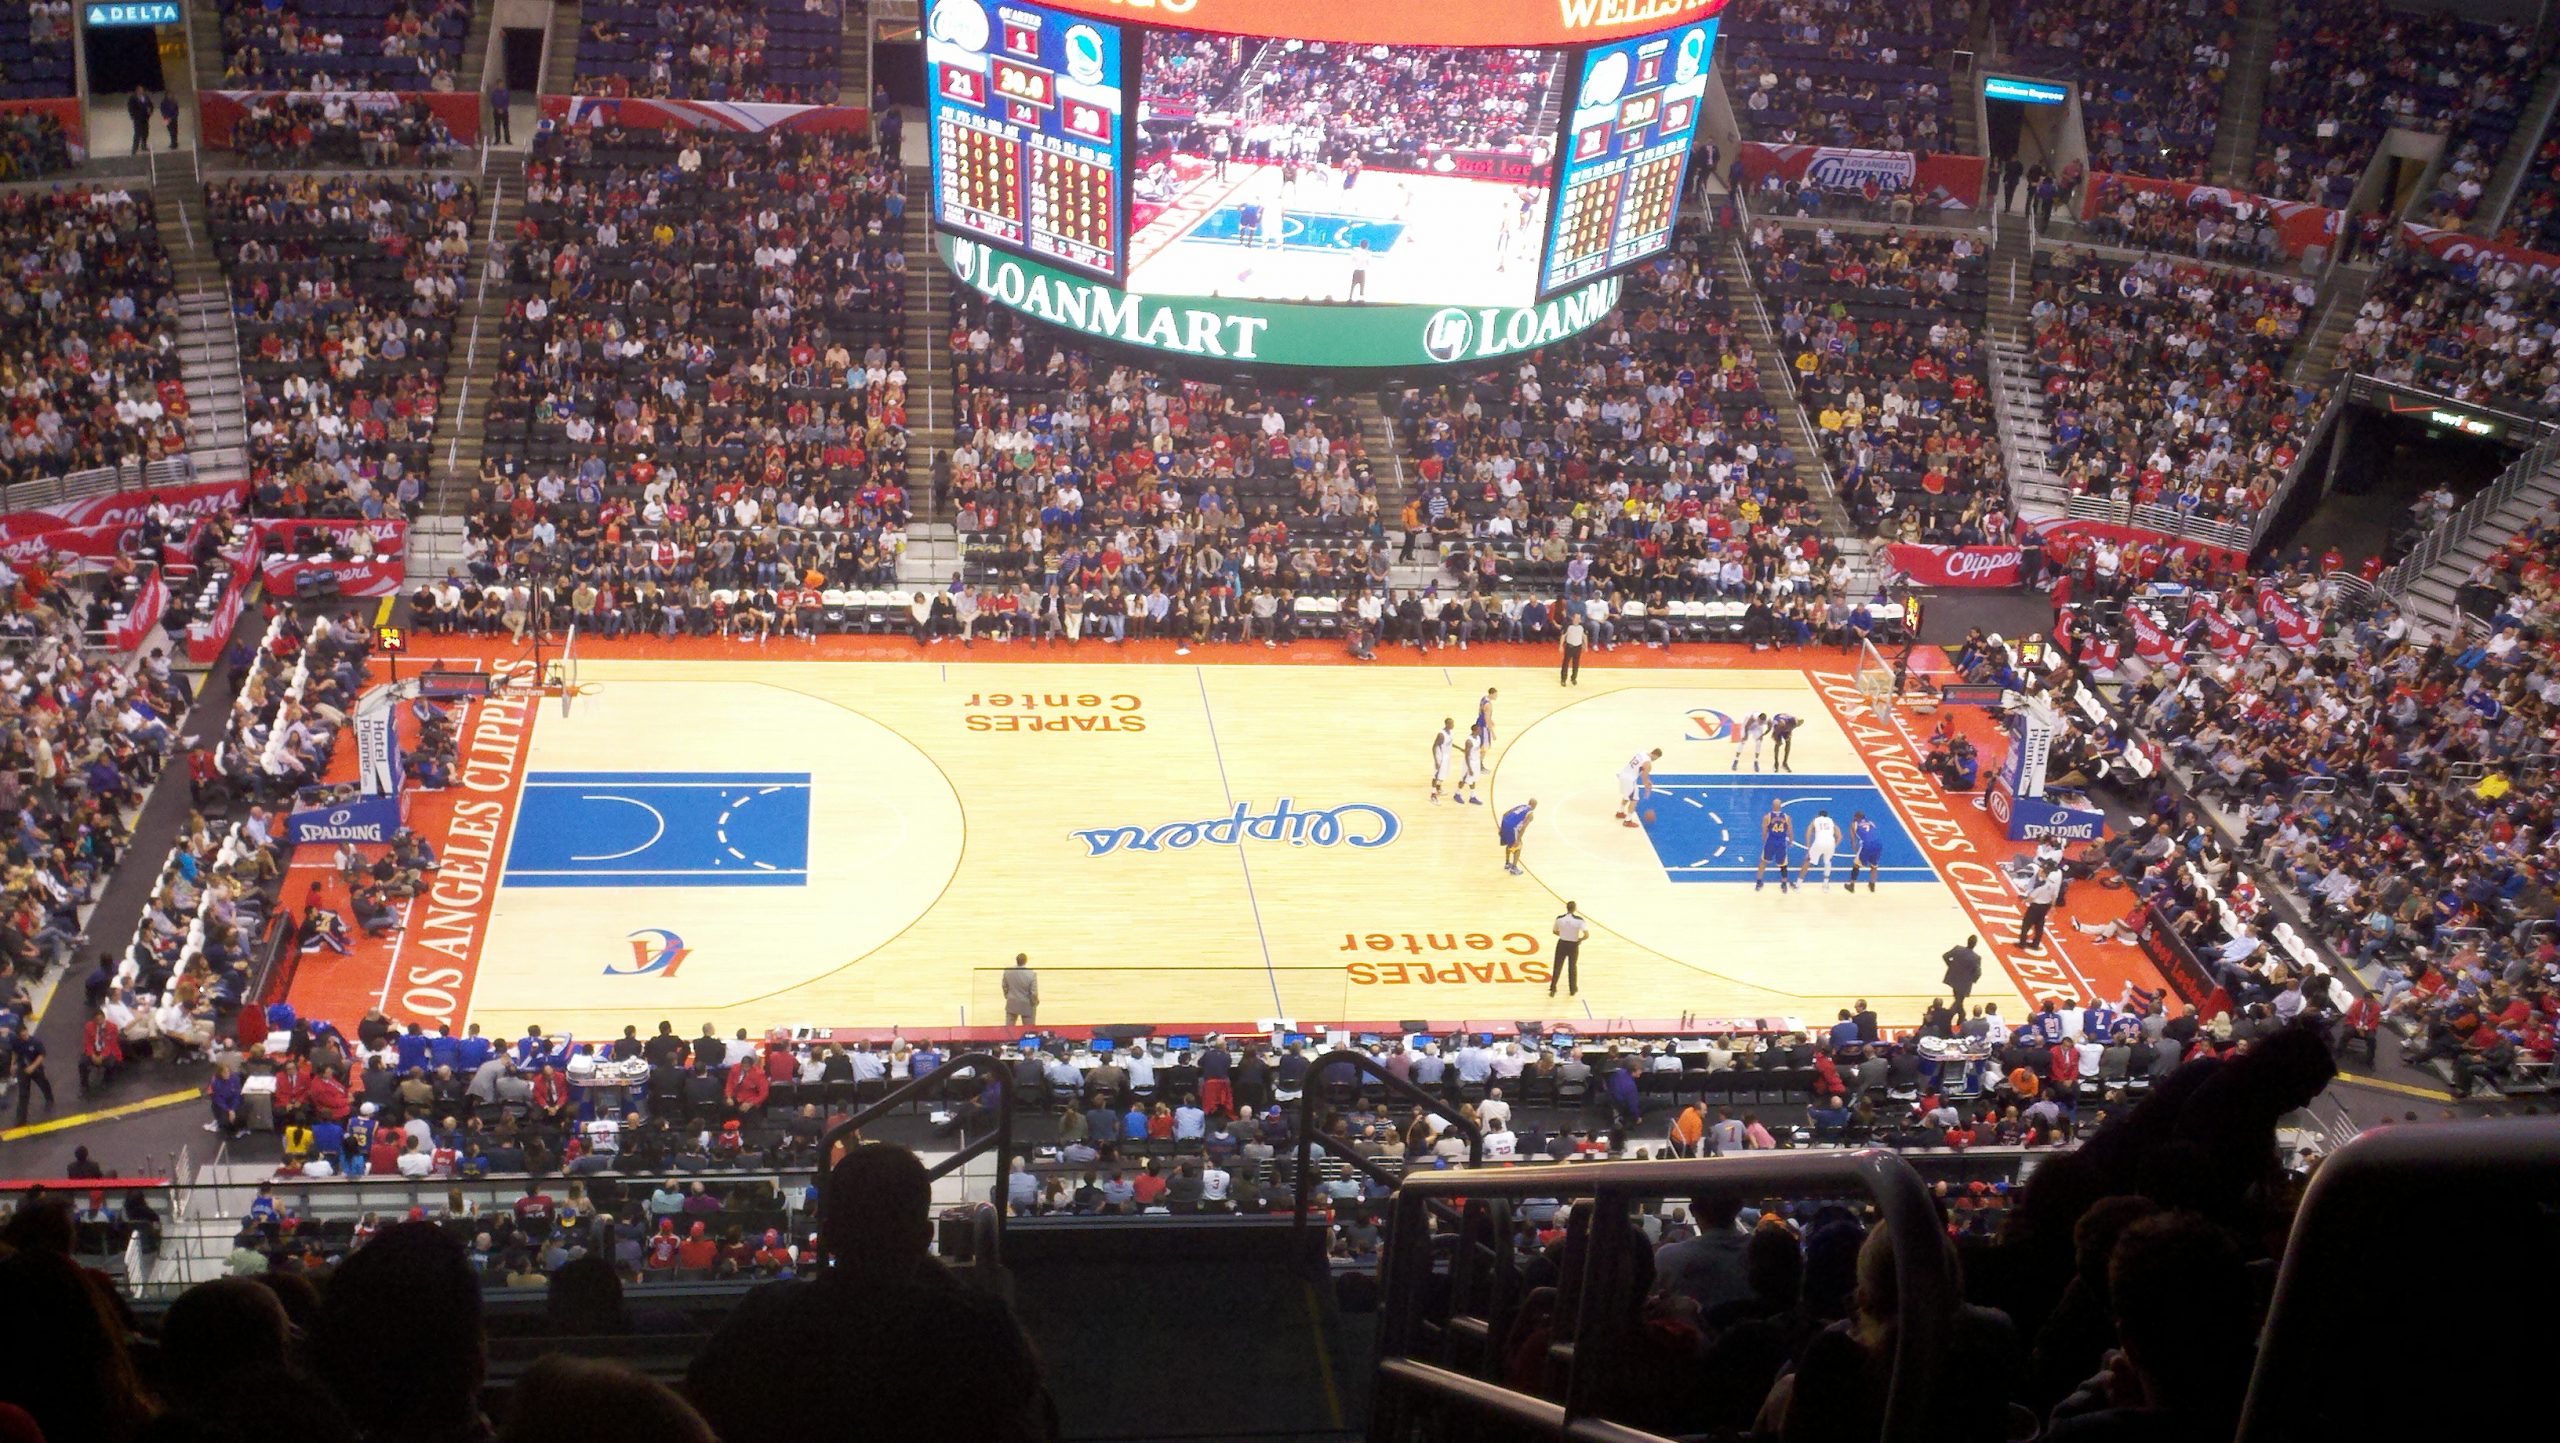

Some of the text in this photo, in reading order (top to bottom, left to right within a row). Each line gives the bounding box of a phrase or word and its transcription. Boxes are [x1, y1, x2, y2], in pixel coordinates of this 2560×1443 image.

[111, 5, 177, 19] DELTA
[1016, 32, 1028, 50] 1
[949, 70, 974, 97] 21
[1016, 104, 1031, 120] 24
[975, 132, 982, 144] 0
[989, 137, 997, 150] 1
[1006, 142, 1013, 154] 0
[959, 143, 968, 157] 0
[975, 148, 982, 160] 0
[989, 152, 998, 166] 0
[1006, 158, 1013, 170] 0
[1034, 150, 1106, 182] 2 0 0 0 0
[1653, 162, 1659, 173] 0
[1673, 155, 1680, 166] 0
[1866, 161, 1906, 170] ANGELES
[960, 160, 969, 173] 2
[976, 165, 983, 177] 1
[990, 169, 998, 182] 0
[1007, 174, 1014, 186] 0
[1034, 165, 1106, 198] 7 4 1 1 0
[1649, 177, 1656, 188] 1
[1659, 173, 1666, 185] 1
[1670, 170, 1677, 181] 0
[1810, 158, 1905, 188] CLIPPERS
[960, 176, 969, 189] 0
[976, 181, 983, 193] 0
[991, 186, 999, 199] 1
[1007, 191, 1014, 202] 1
[1590, 175, 1619, 194] 0 1 0
[1066, 193, 1073, 205] 1
[1082, 198, 1090, 211] 2
[1098, 203, 1106, 215] 3
[1587, 198, 1593, 209] 0
[1609, 190, 1616, 202] 0
[1646, 193, 1652, 204] 1
[1666, 186, 1673, 197] 3
[977, 198, 983, 209] 1
[1008, 207, 1015, 219] 3
[1050, 204, 1106, 231] 0 0 0 0
[1584, 214, 1590, 225] 1
[1606, 206, 1613, 217] 0
[1643, 208, 1649, 220] 0
[1663, 201, 1670, 212] 0
[969, 213, 976, 225] 4
[1639, 216, 1667, 235] 0 1 0
[1008, 226, 1016, 237] 5
[1067, 225, 1074, 237] 0
[1082, 230, 1090, 243] 1
[1099, 236, 1107, 248] 0
[1580, 230, 1587, 241] 0
[1603, 223, 1609, 233] 1
[1059, 242, 1066, 253] 5
[1577, 246, 1583, 257] 1
[1098, 255, 1106, 267] 5
[976, 244, 1268, 359] LOANMART
[1946, 551, 2023, 579] Clipper
[965, 694, 1142, 711] Center
[965, 715, 1146, 731] STAPLES
[359, 719, 372, 774] Planner
[373, 720, 386, 763] Hotel
[1995, 794, 2006, 821] KIA
[300, 823, 382, 841] SPALDING
[1069, 798, 1400, 856] Clippers
[1772, 824, 1784, 833] 44
[2023, 823, 2093, 840] SPALDING
[1851, 722, 1977, 854] ANGELES
[1946, 861, 2080, 1009] CLIPPER
[418, 800, 503, 961] ANGELES
[1340, 933, 1540, 955] Center
[1347, 961, 1553, 985] STAPLES
[2095, 1012, 2104, 1026] 7
